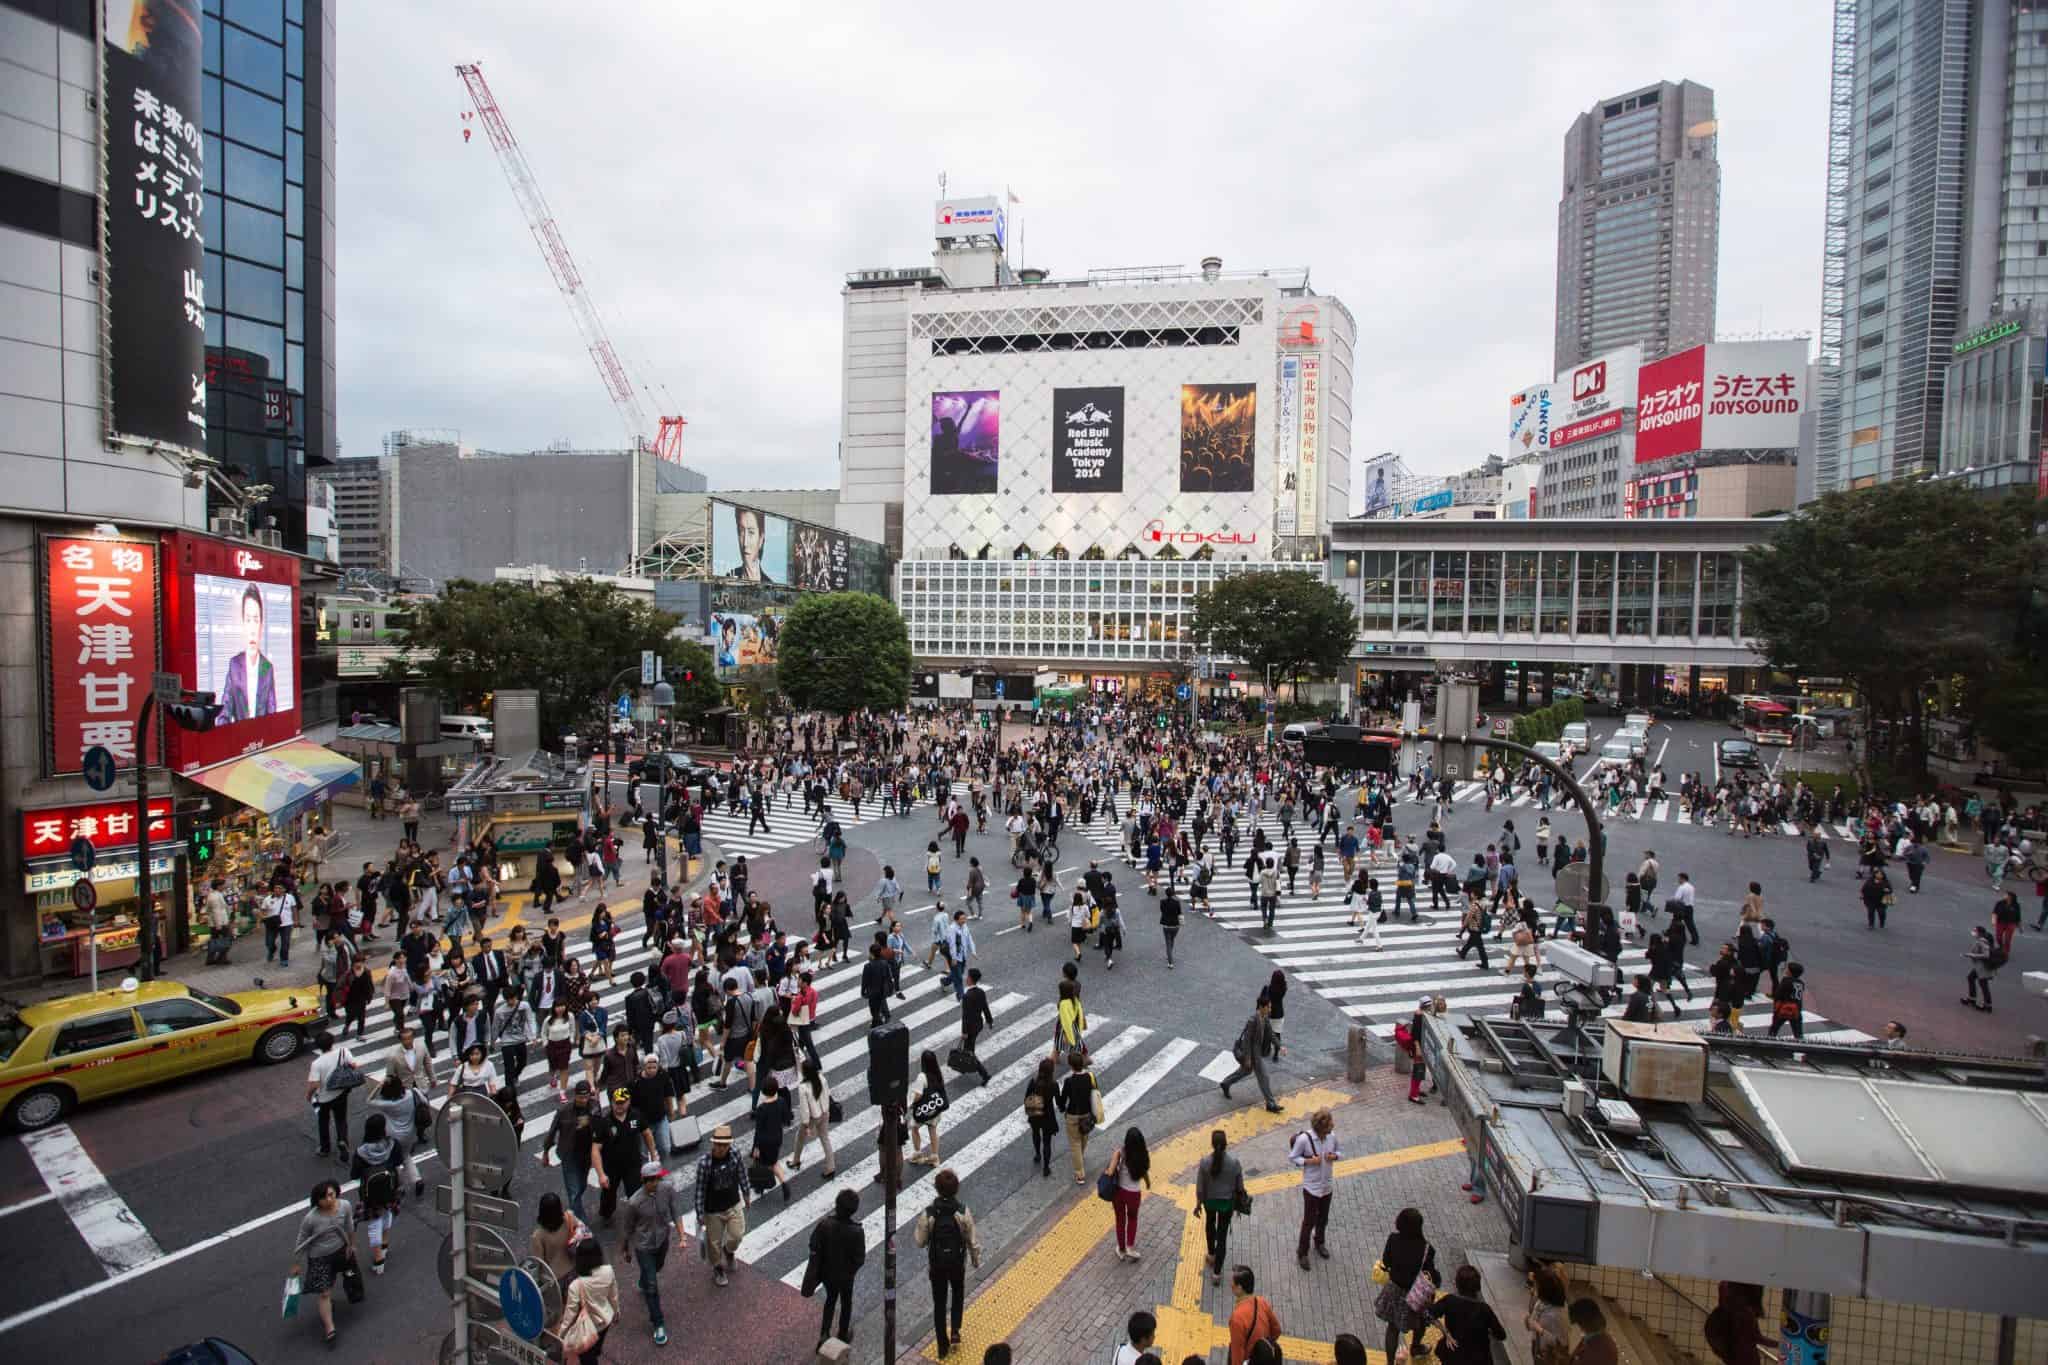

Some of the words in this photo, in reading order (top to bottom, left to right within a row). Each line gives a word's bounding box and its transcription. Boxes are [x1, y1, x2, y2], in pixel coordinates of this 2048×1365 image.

[1713, 373, 1795, 398] うたスキ
[1640, 381, 1701, 417] カラオケ
[1708, 399, 1799, 415] JOYSOUND
[1538, 390, 1552, 445] SANKYO
[1638, 403, 1701, 432] JOYSOUND
[1068, 428, 1087, 438] Red
[1089, 427, 1109, 438] Bull
[1074, 438, 1104, 447] Music
[1065, 447, 1112, 458] Academy
[1072, 458, 1105, 469] Tokyo
[1075, 468, 1101, 479] 2014
[1162, 532, 1256, 544] TOKYU
[62, 545, 144, 573] 名物
[76, 576, 137, 760] 天津甘栗
